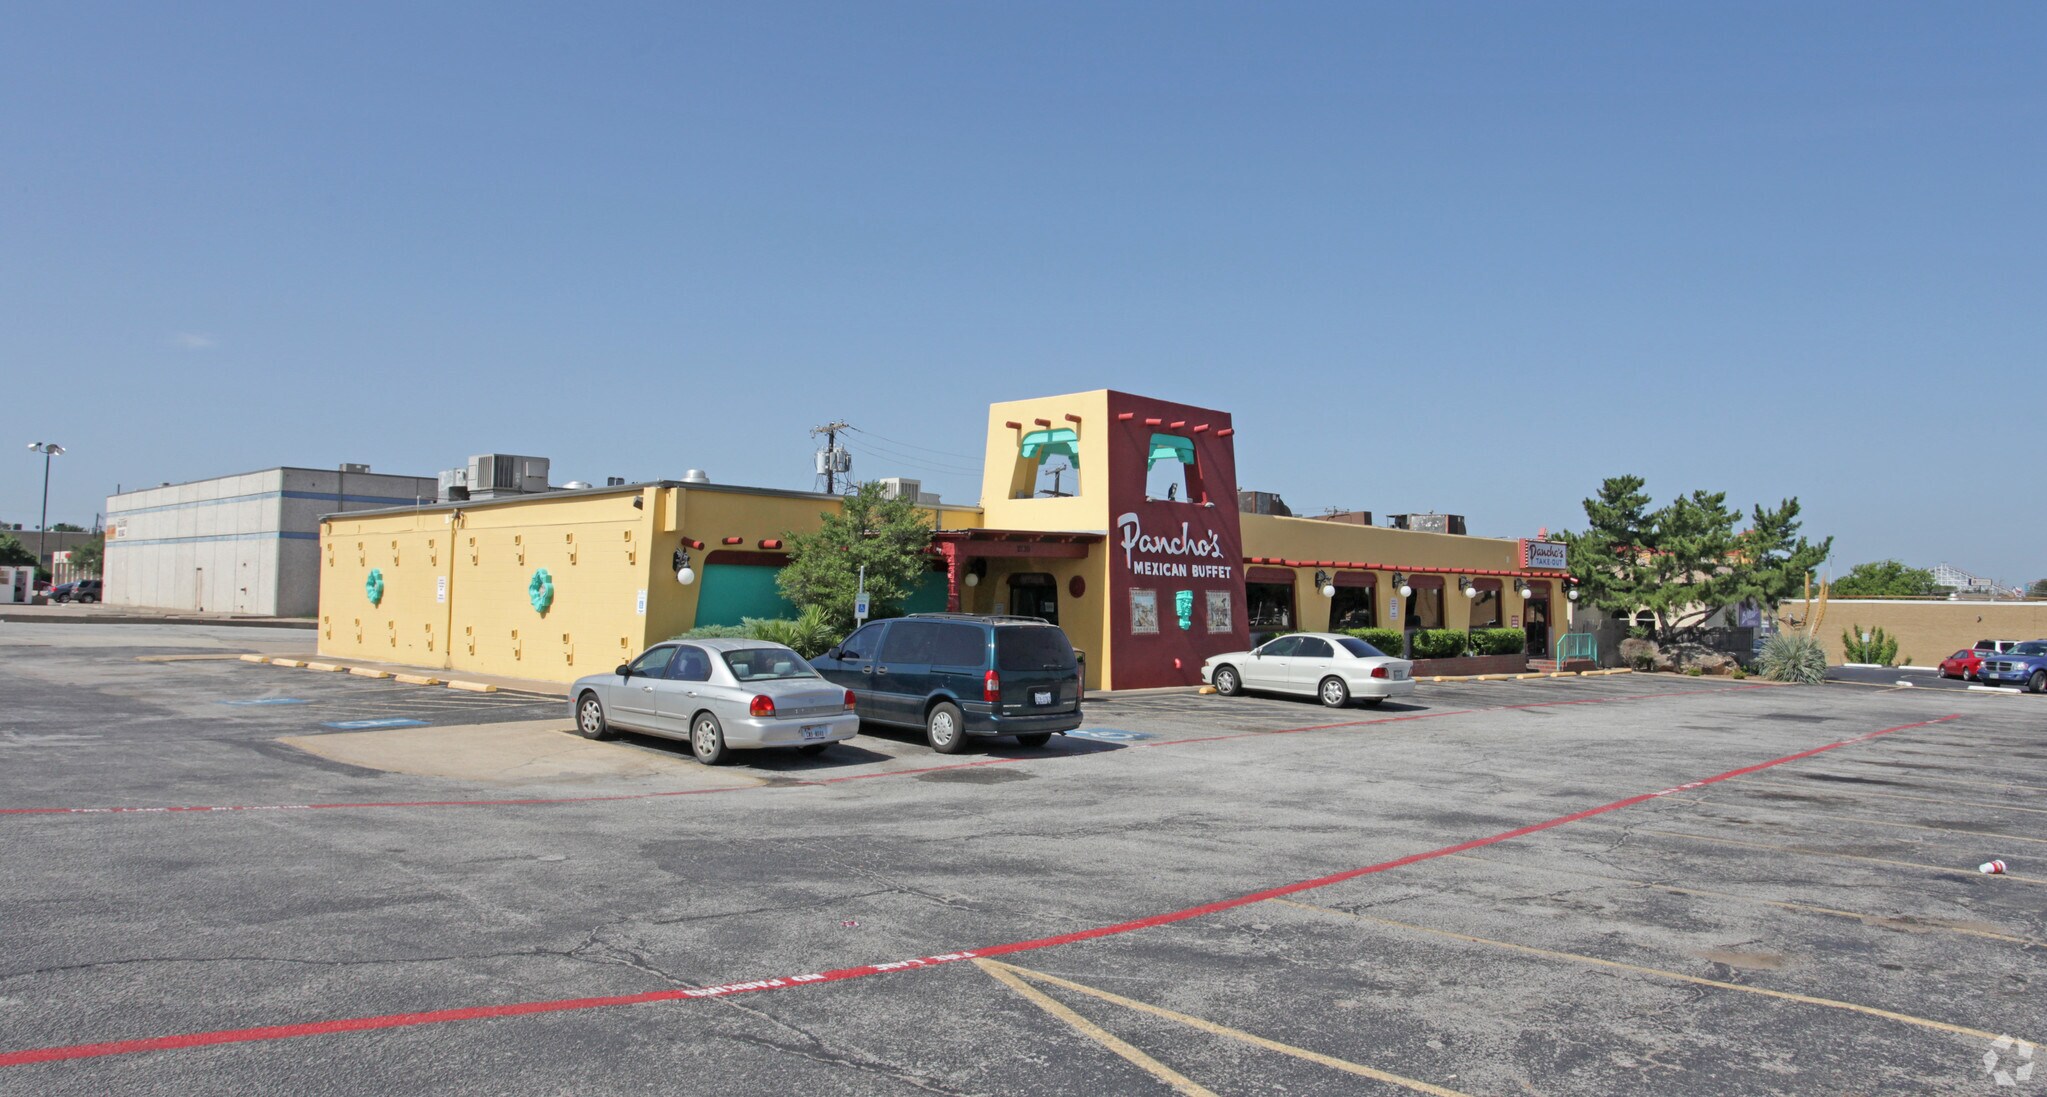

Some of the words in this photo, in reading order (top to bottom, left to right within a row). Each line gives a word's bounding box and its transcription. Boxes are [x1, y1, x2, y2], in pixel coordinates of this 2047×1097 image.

[1117, 512, 1224, 569] Pancho's
[1530, 544, 1563, 565] Pancho's
[1536, 558, 1563, 566] TAKE-OUT
[1133, 561, 1187, 577] MEXICAN
[1192, 564, 1232, 579] BUFFET
